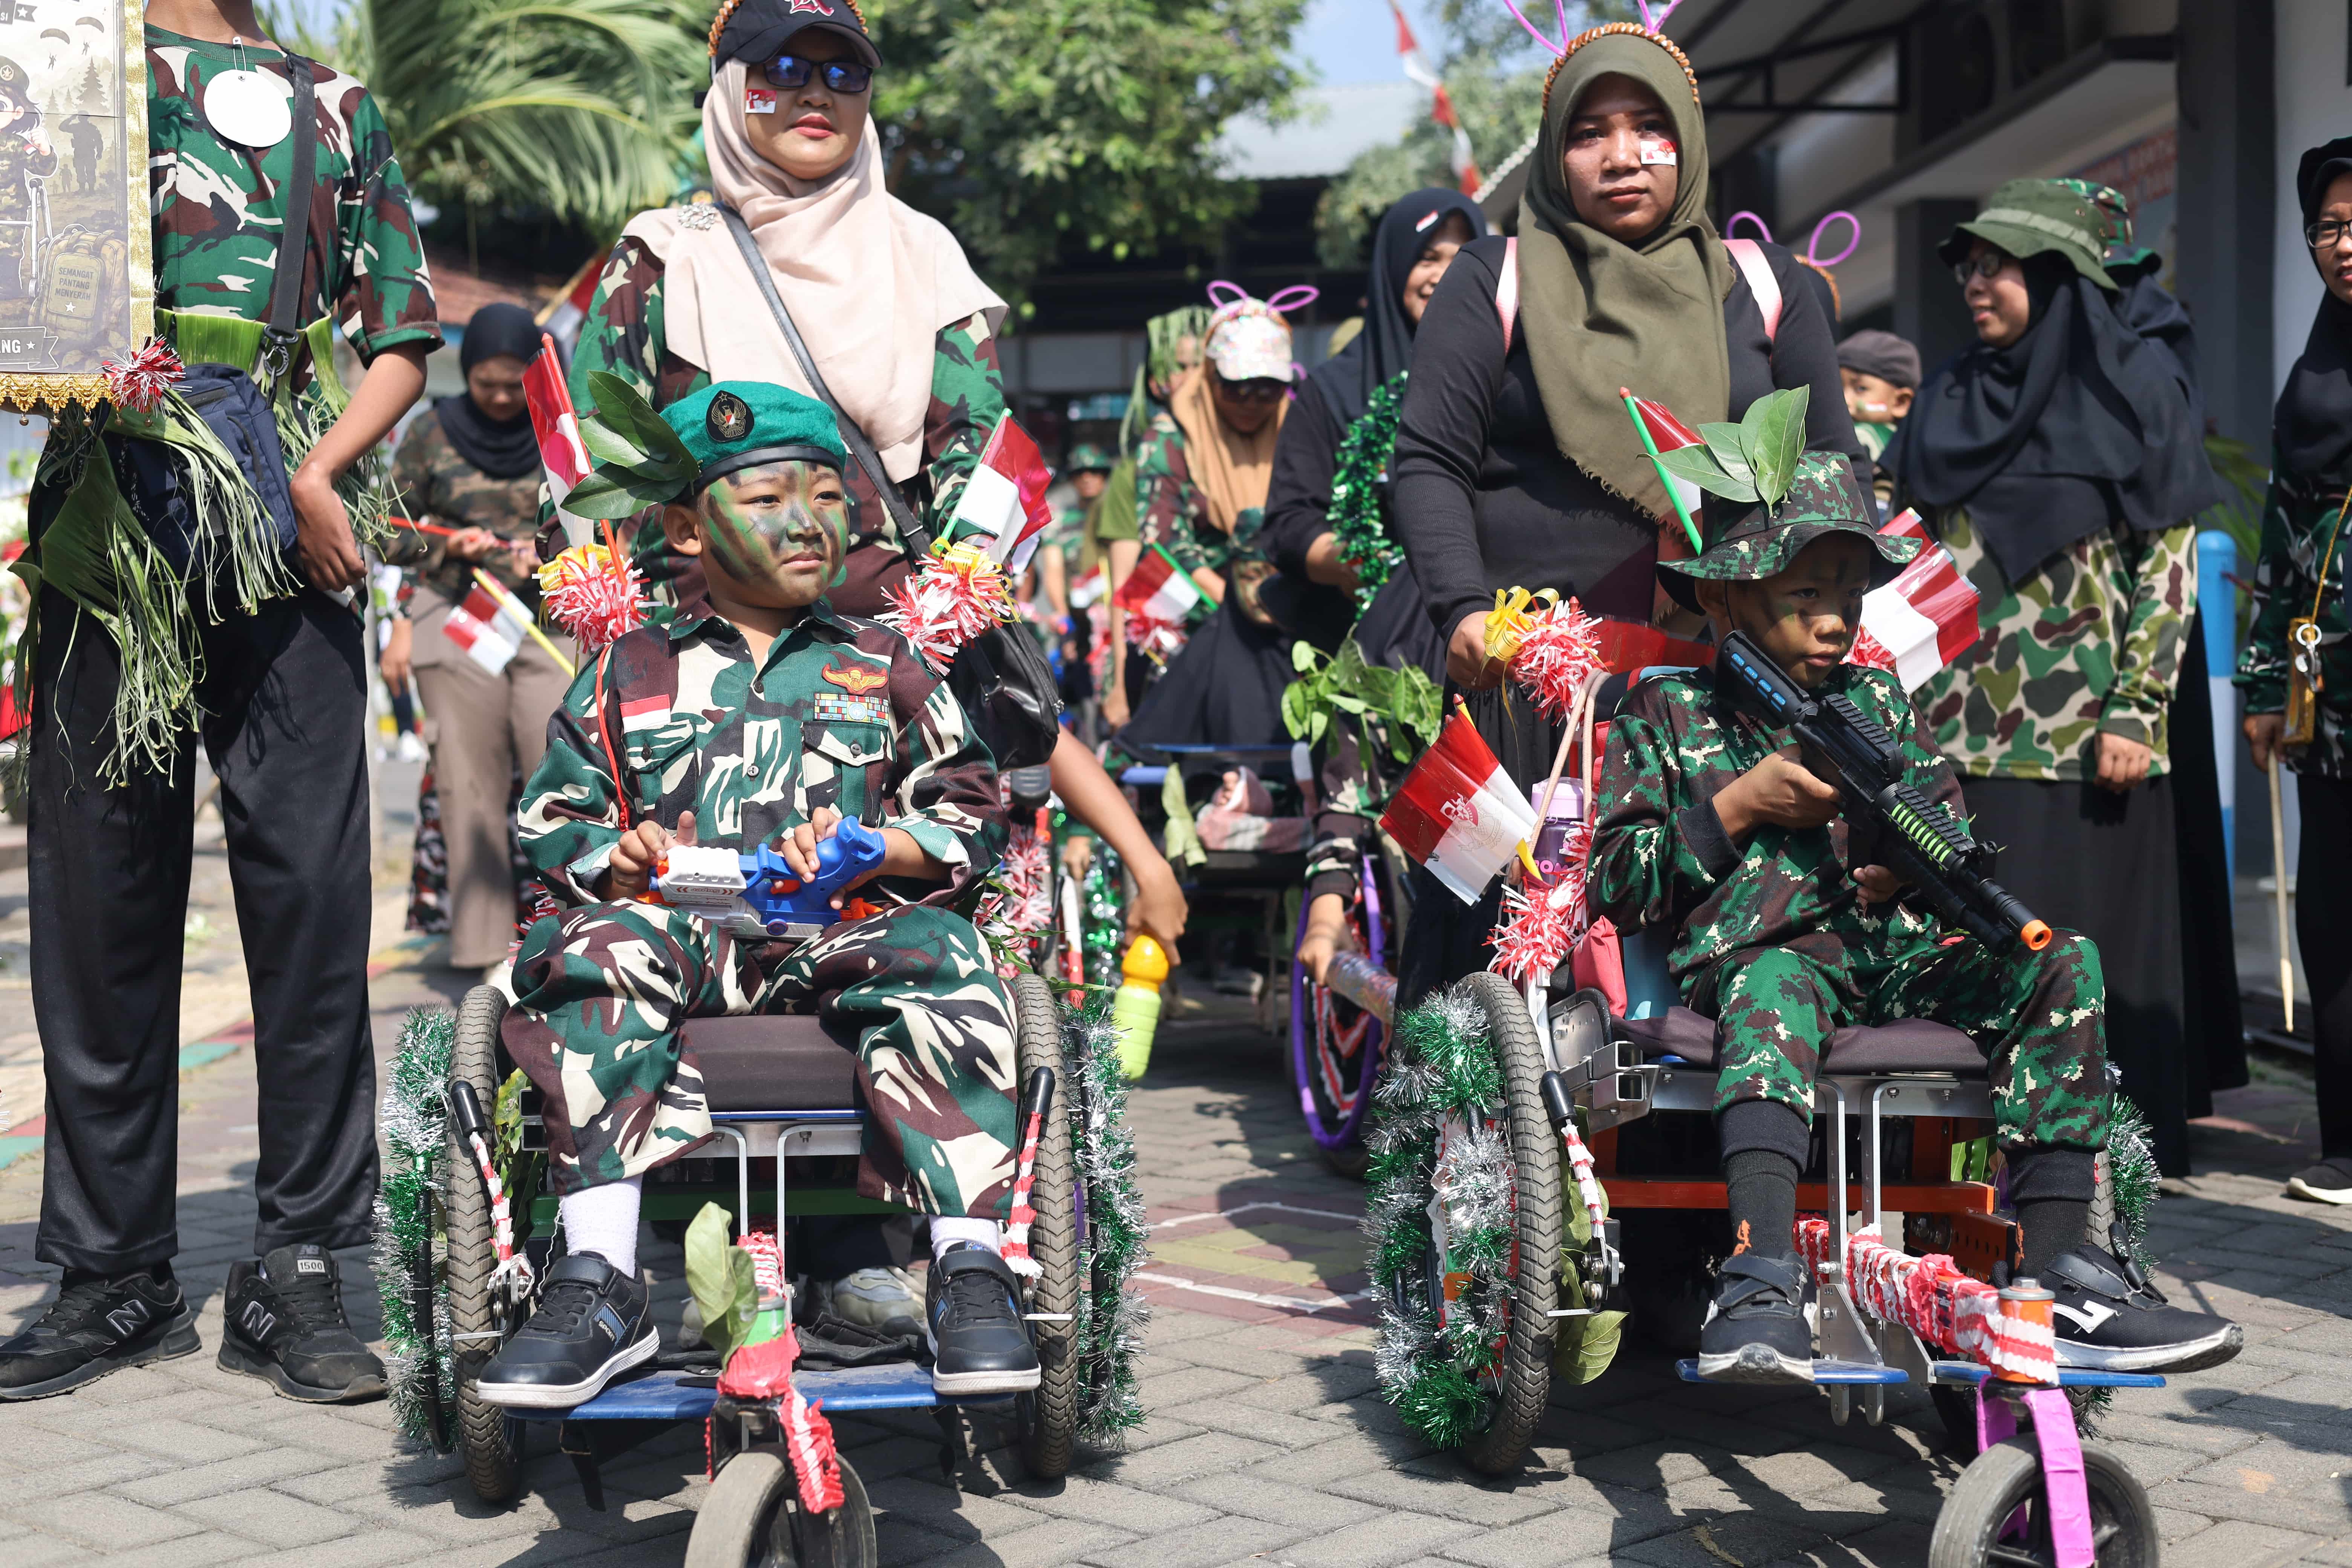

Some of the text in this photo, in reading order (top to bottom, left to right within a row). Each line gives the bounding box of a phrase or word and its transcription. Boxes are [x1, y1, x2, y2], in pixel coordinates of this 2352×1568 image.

[58, 267, 93, 279] SEMANGAT
[59, 278, 90, 289] PANTANG
[55, 288, 90, 300] MENYERAH
[0, 339, 21, 353] NG
[106, 1299, 150, 1336] N
[239, 1300, 276, 1342] N
[598, 1320, 616, 1342] SPORT
